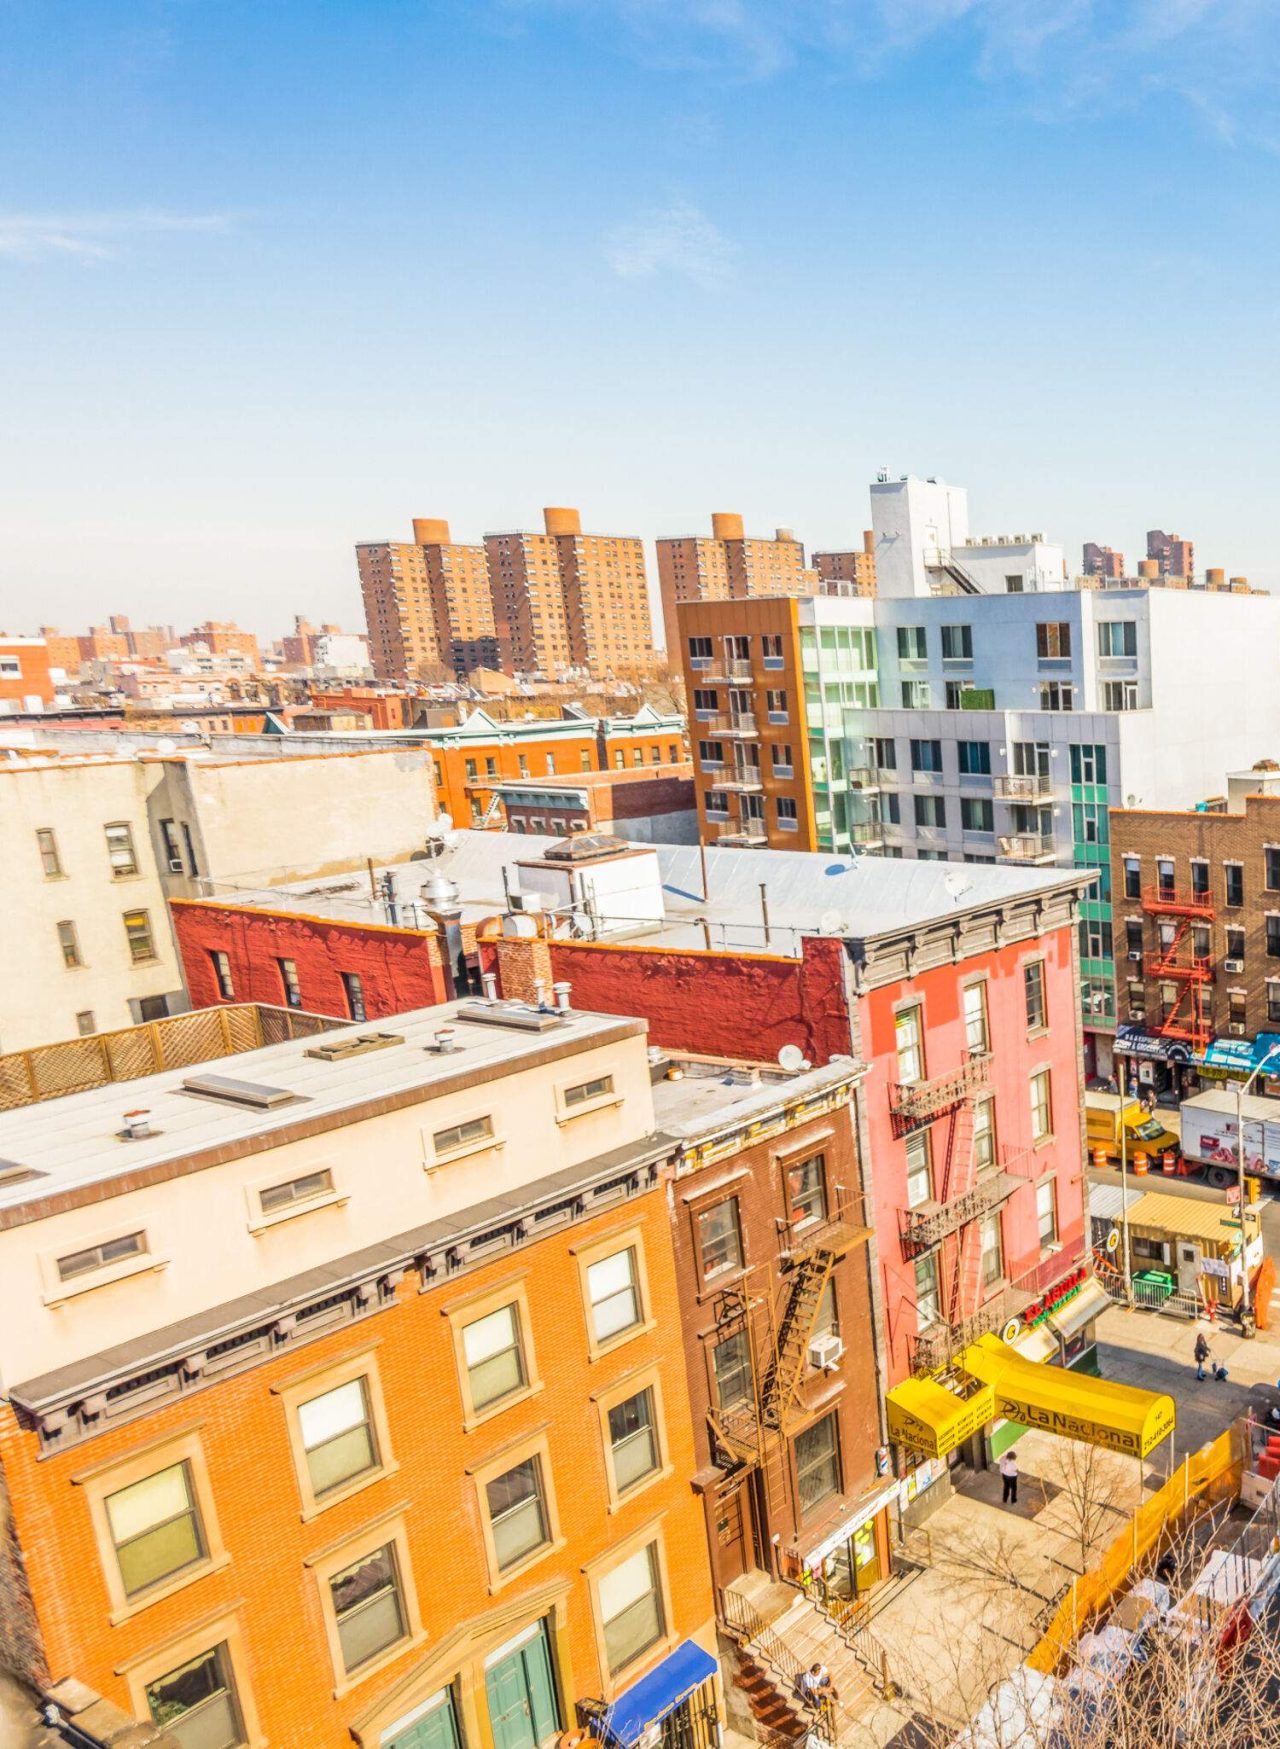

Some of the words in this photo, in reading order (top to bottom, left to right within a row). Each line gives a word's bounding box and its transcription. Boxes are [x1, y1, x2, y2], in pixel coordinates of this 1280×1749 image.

[890, 1423, 901, 1436] La
[901, 1427, 935, 1450] Nacional
[1027, 1404, 1050, 1426] La
[1052, 1411, 1141, 1450] Nacional
